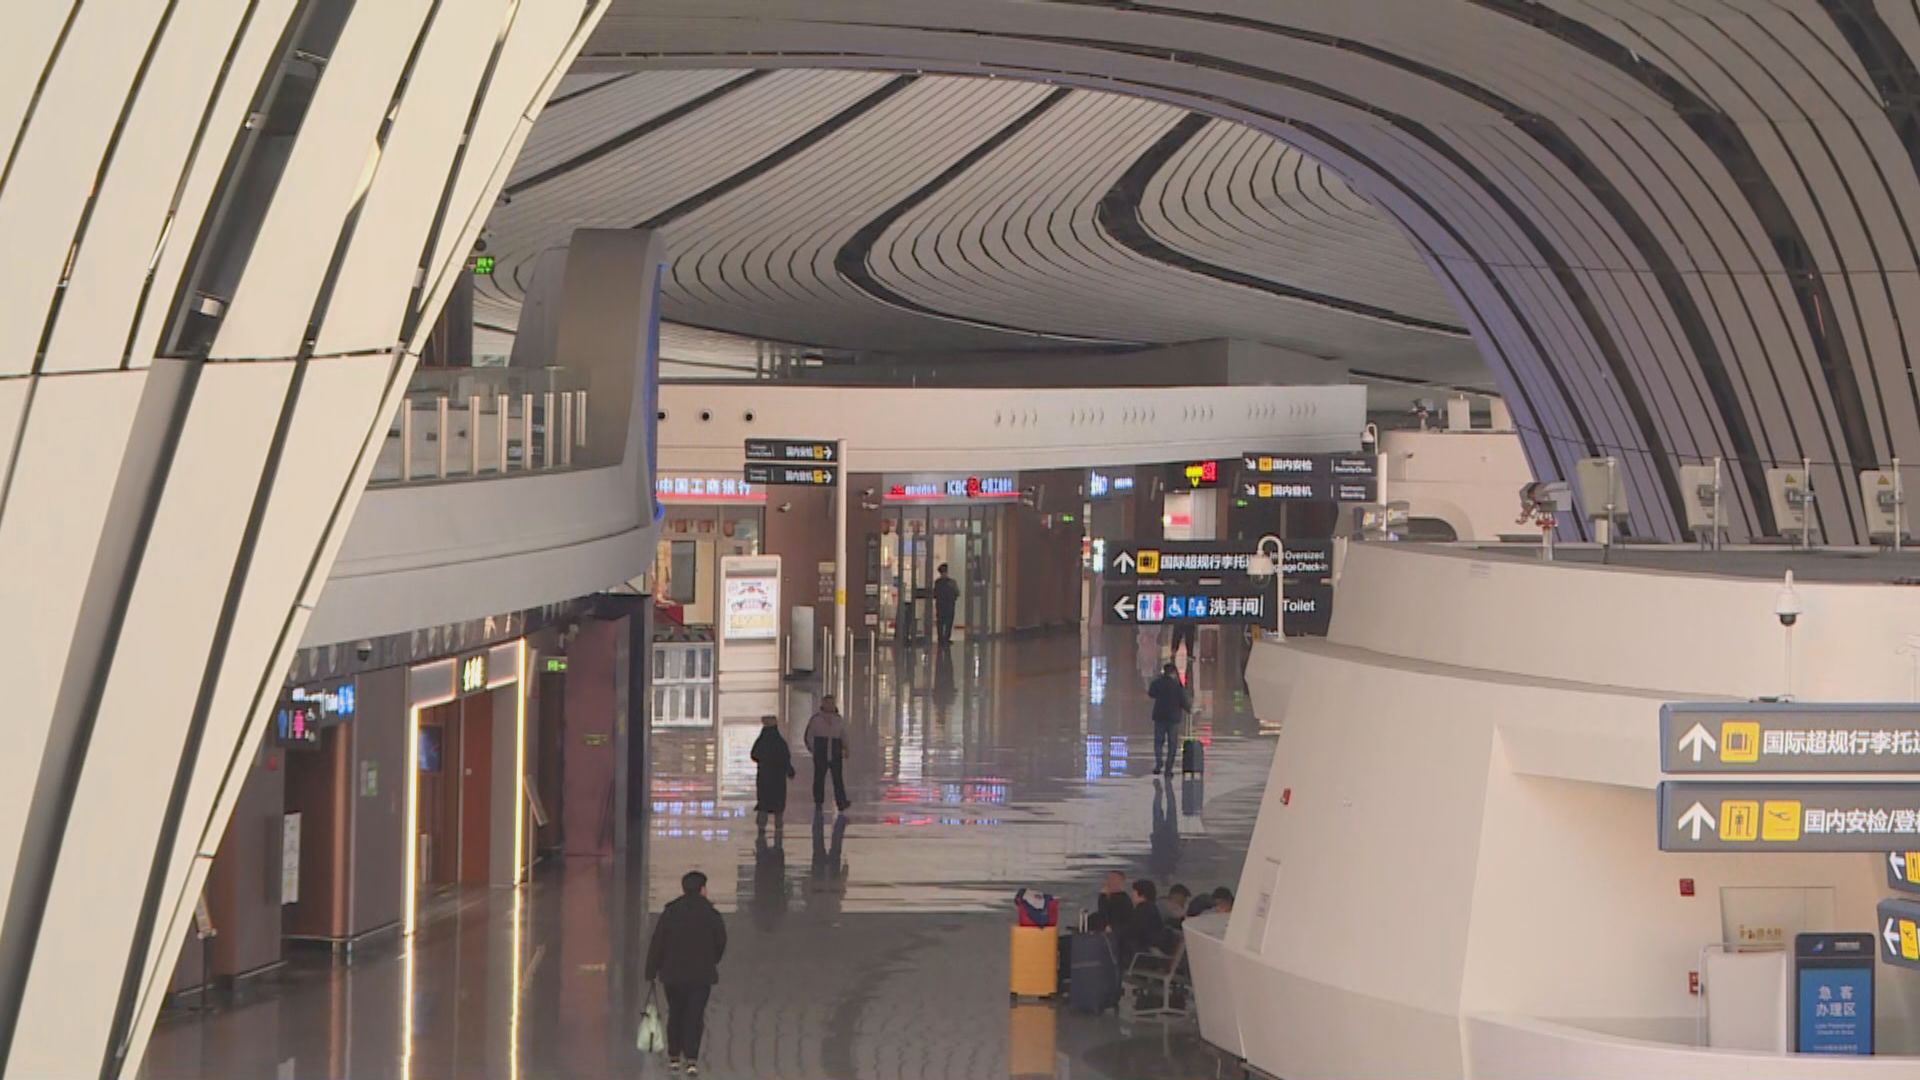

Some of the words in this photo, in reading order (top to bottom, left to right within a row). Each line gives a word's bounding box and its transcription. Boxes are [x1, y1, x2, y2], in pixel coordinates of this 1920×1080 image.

[1272, 459, 1312, 471] 国内安检
[947, 480, 967, 496] ICBC
[1272, 485, 1312, 497] 国内登机
[1209, 597, 1258, 616] 洗手间
[1283, 599, 1315, 612] Toilet
[1804, 808, 1920, 833] 国内安检/登
[1816, 1002, 1856, 1017] 办理区
